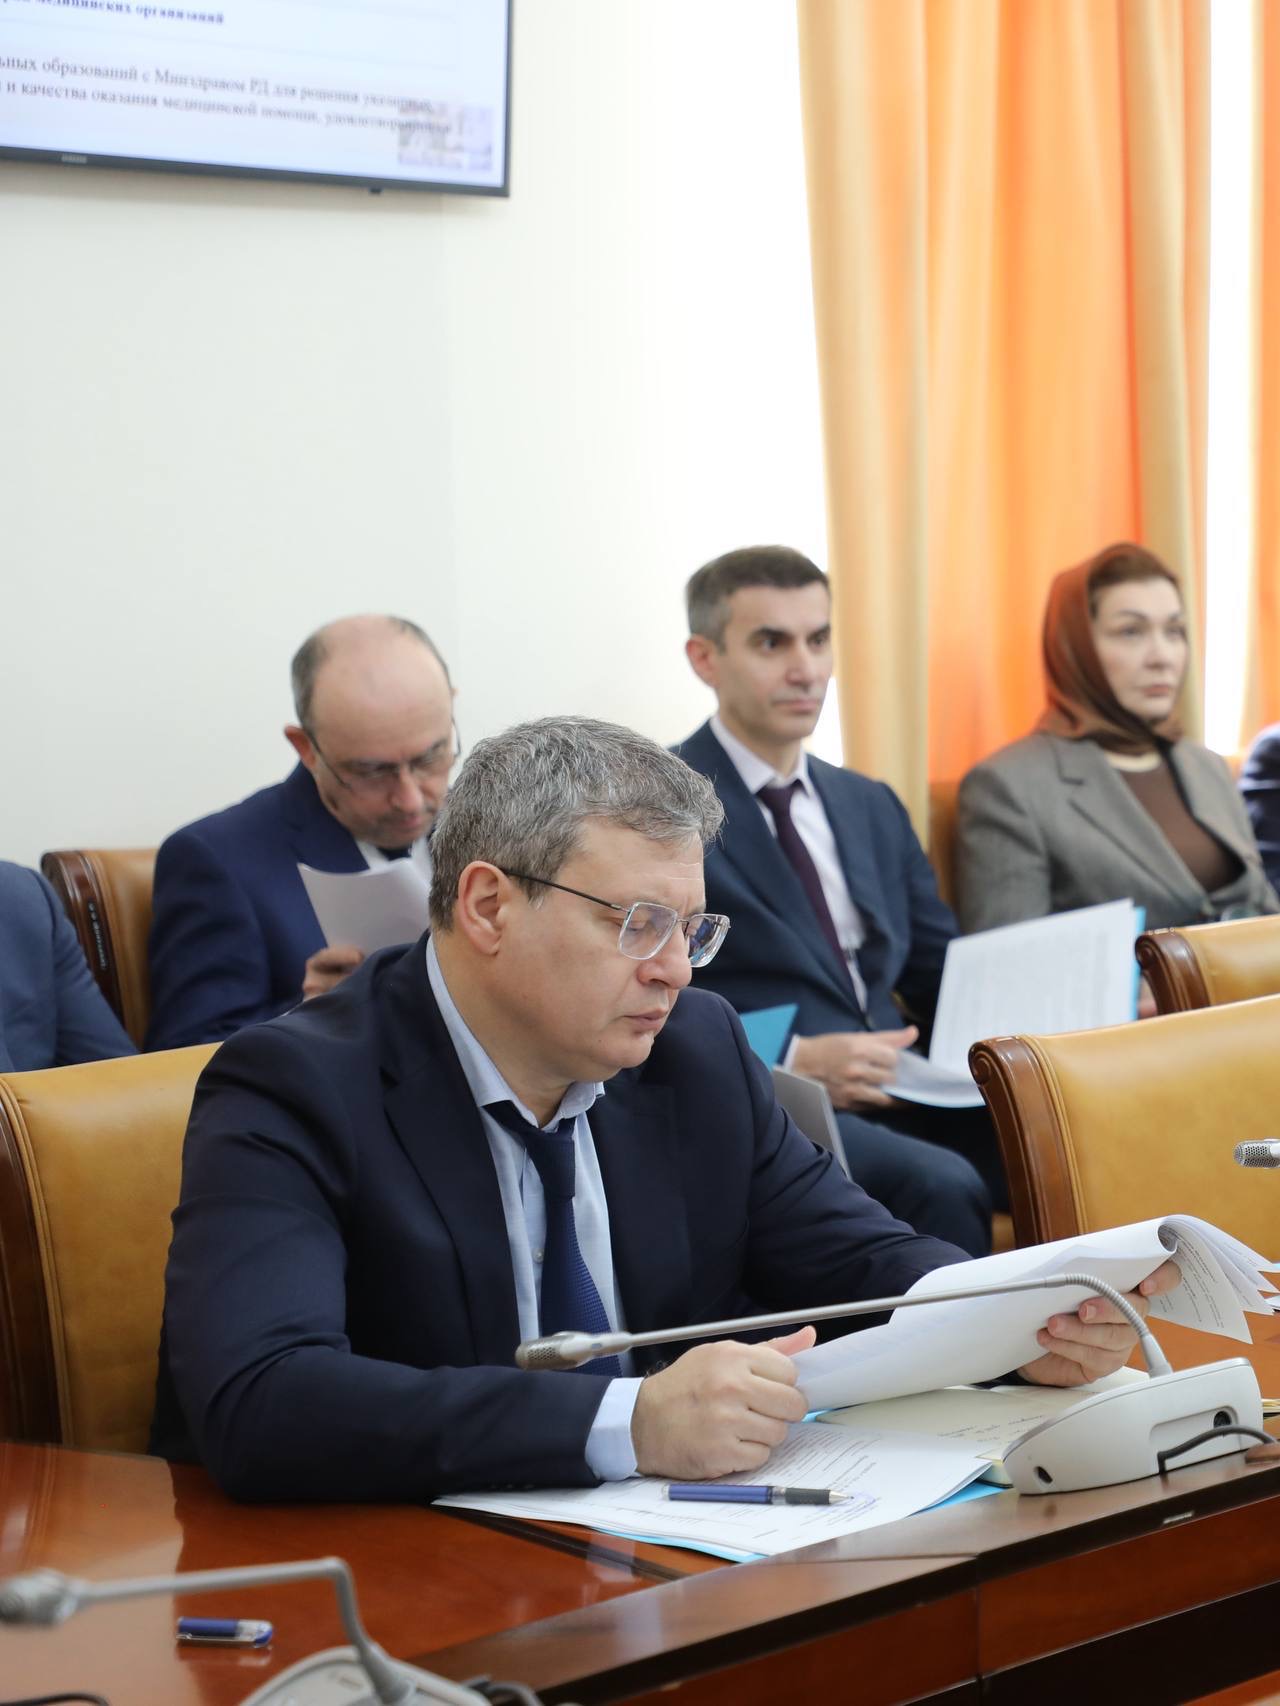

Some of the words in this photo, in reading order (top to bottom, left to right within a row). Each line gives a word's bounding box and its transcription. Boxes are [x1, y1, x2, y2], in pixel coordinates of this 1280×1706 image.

[43, 53, 137, 81] образований
[142, 72, 151, 82] с
[22, 84, 87, 101] качества
[91, 92, 157, 107] оказания
